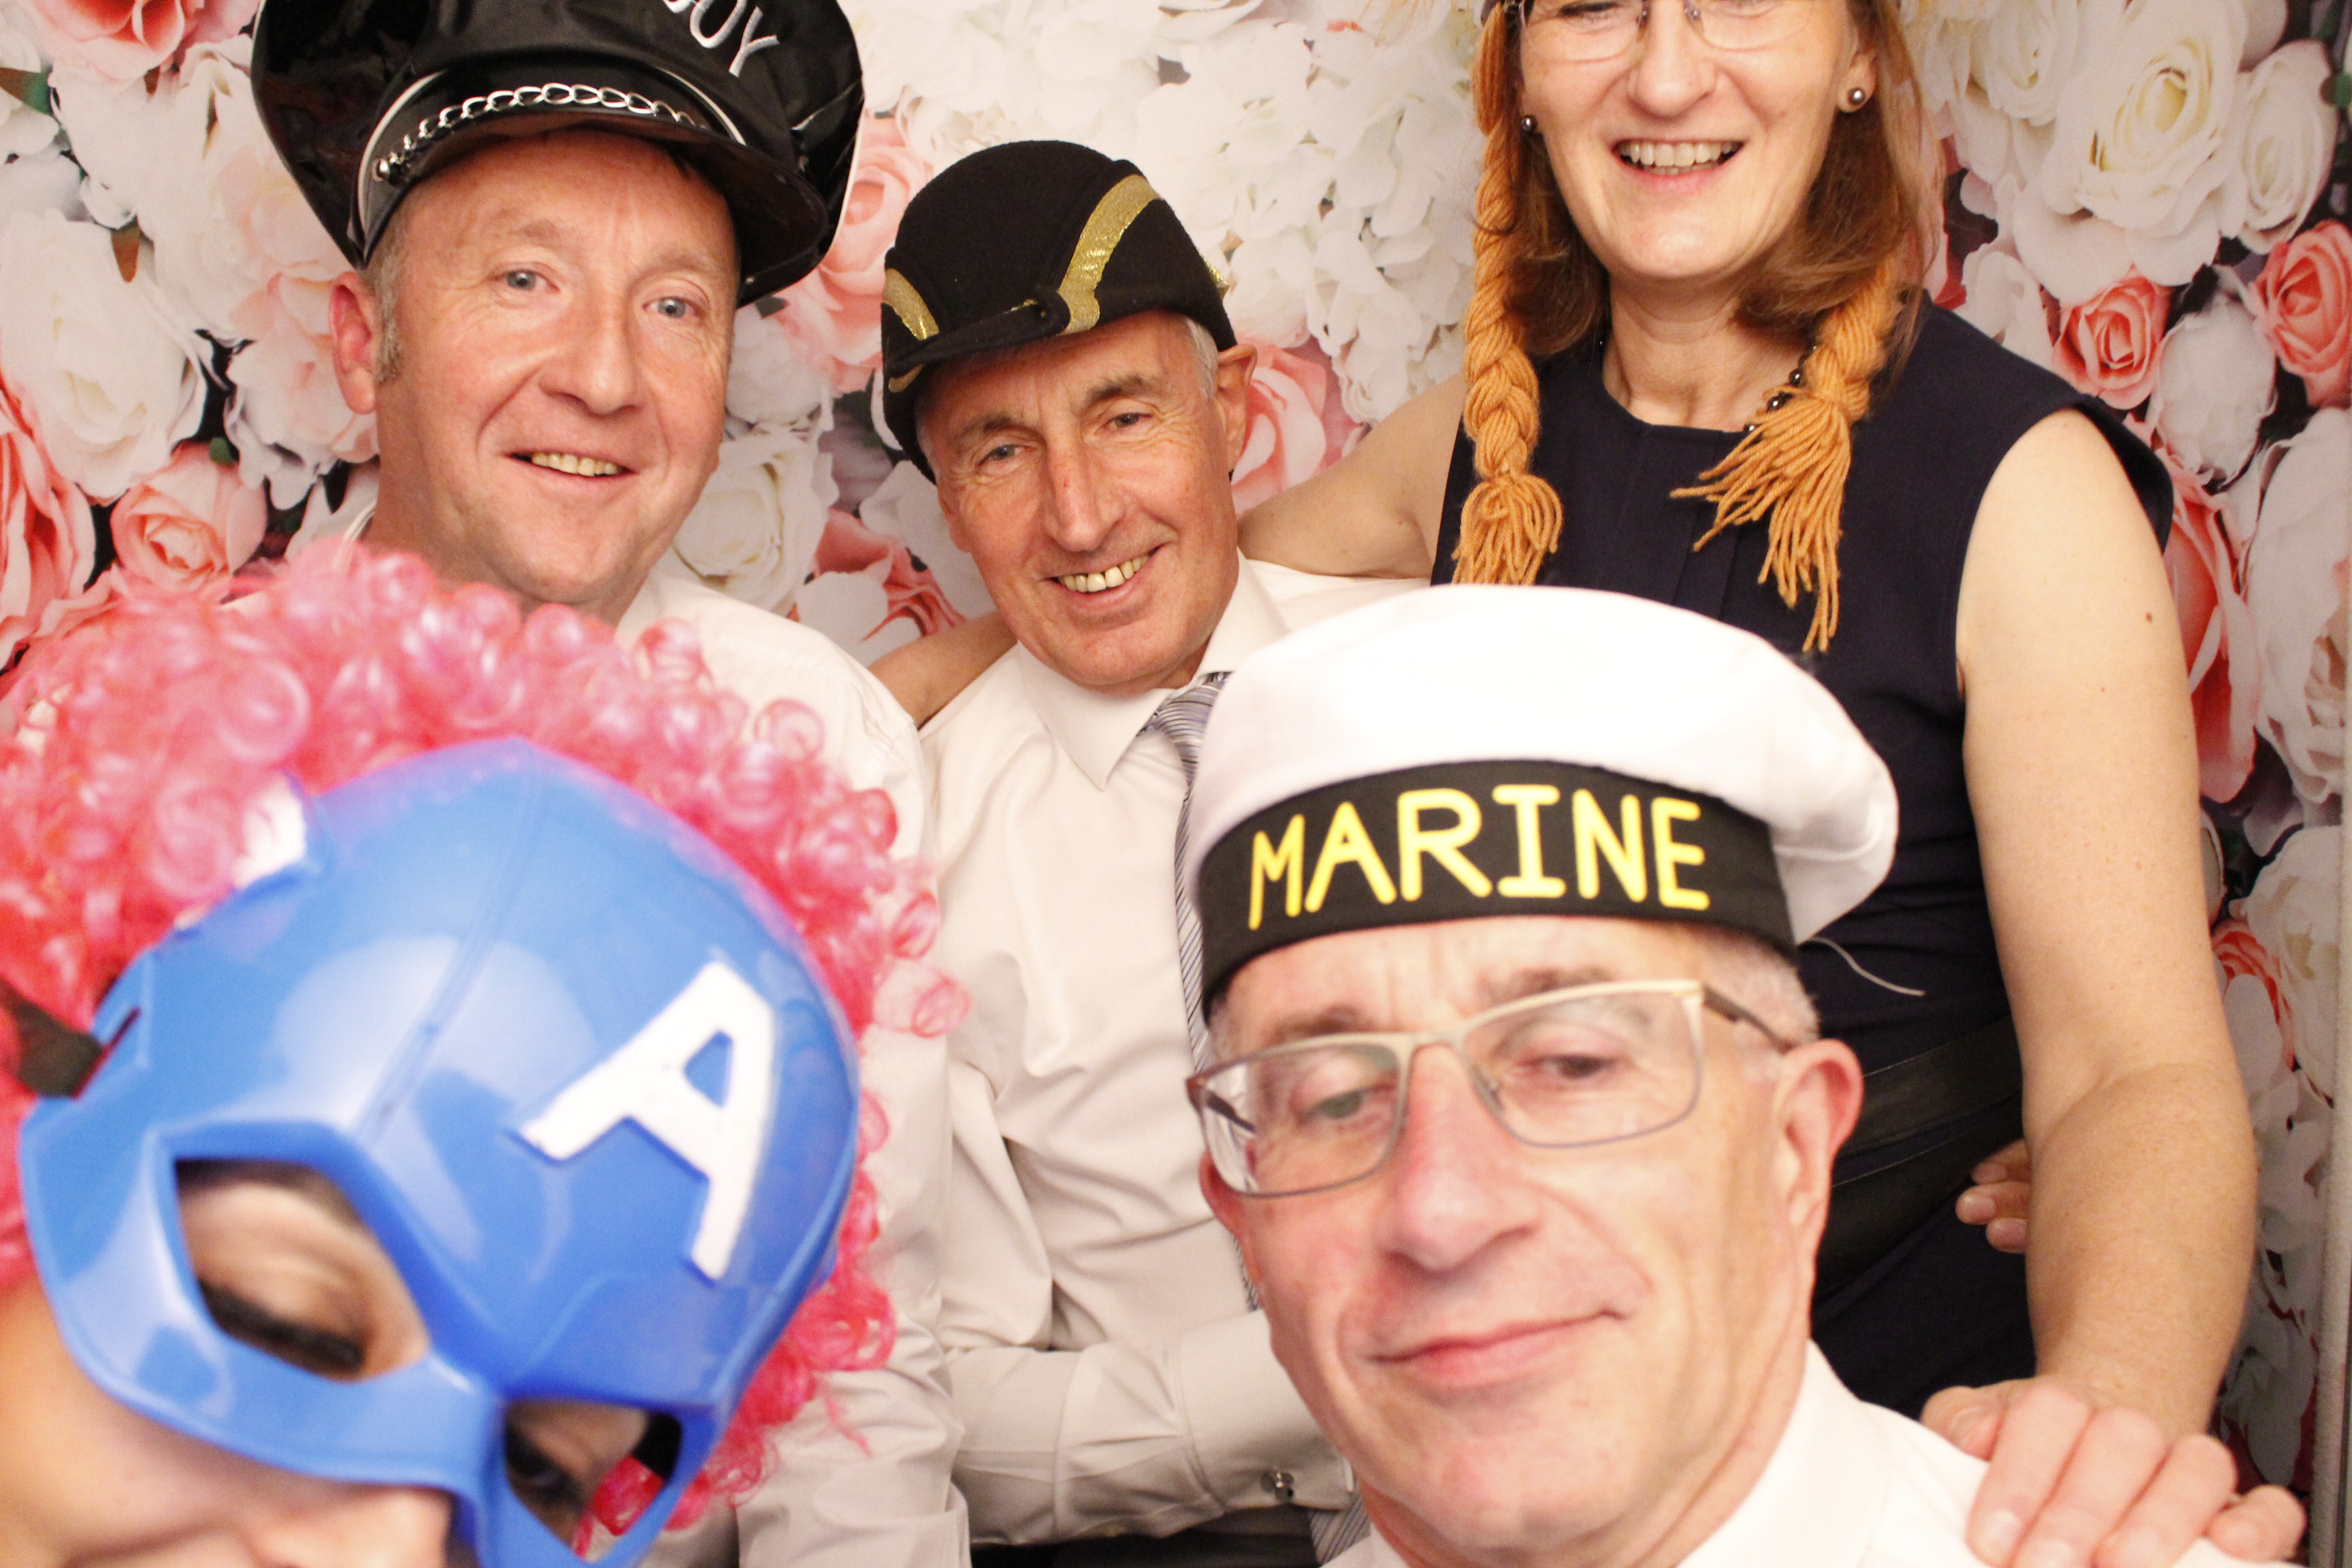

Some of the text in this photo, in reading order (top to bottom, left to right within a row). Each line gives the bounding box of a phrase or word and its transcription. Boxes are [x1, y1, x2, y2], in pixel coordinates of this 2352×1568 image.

[663, 0, 780, 78] OY
[1247, 784, 1710, 930] MARINE
[517, 960, 776, 1281] A
